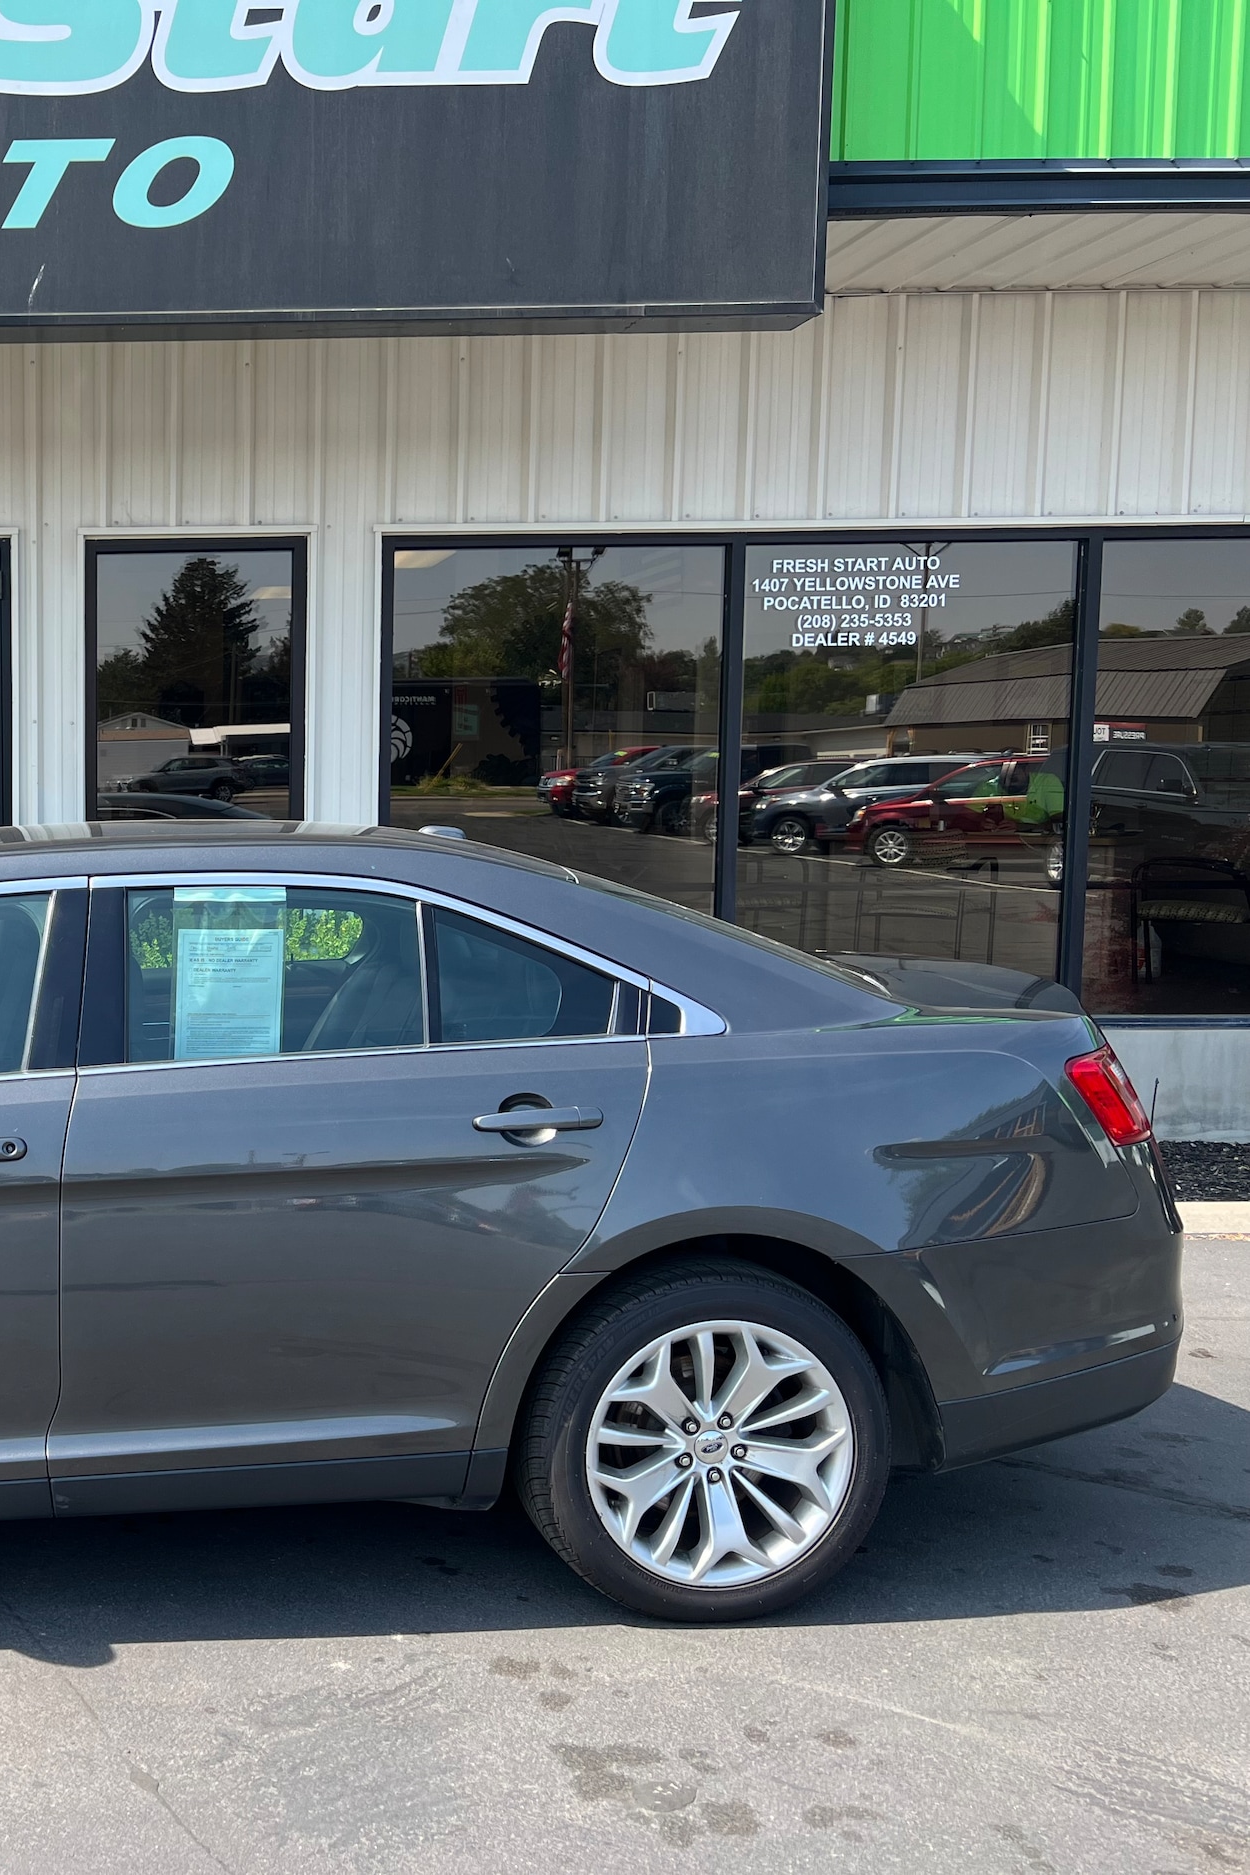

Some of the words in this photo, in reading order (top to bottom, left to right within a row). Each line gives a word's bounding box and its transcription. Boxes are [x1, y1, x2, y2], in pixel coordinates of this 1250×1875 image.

[772, 558, 829, 573] FRESH
[833, 557, 889, 572] START
[892, 556, 940, 571] AUTO
[752, 578, 789, 592] 1407
[793, 575, 922, 591] YELLOWSTONE
[926, 574, 960, 589] AVE
[763, 594, 869, 611] POCATELLO,
[874, 594, 891, 608] ID
[900, 593, 946, 608] 83201
[798, 613, 836, 632] (208)
[840, 613, 912, 628] 235-5353
[792, 632, 860, 647] DEALER
[864, 632, 875, 646] #
[878, 631, 917, 646] 4549
